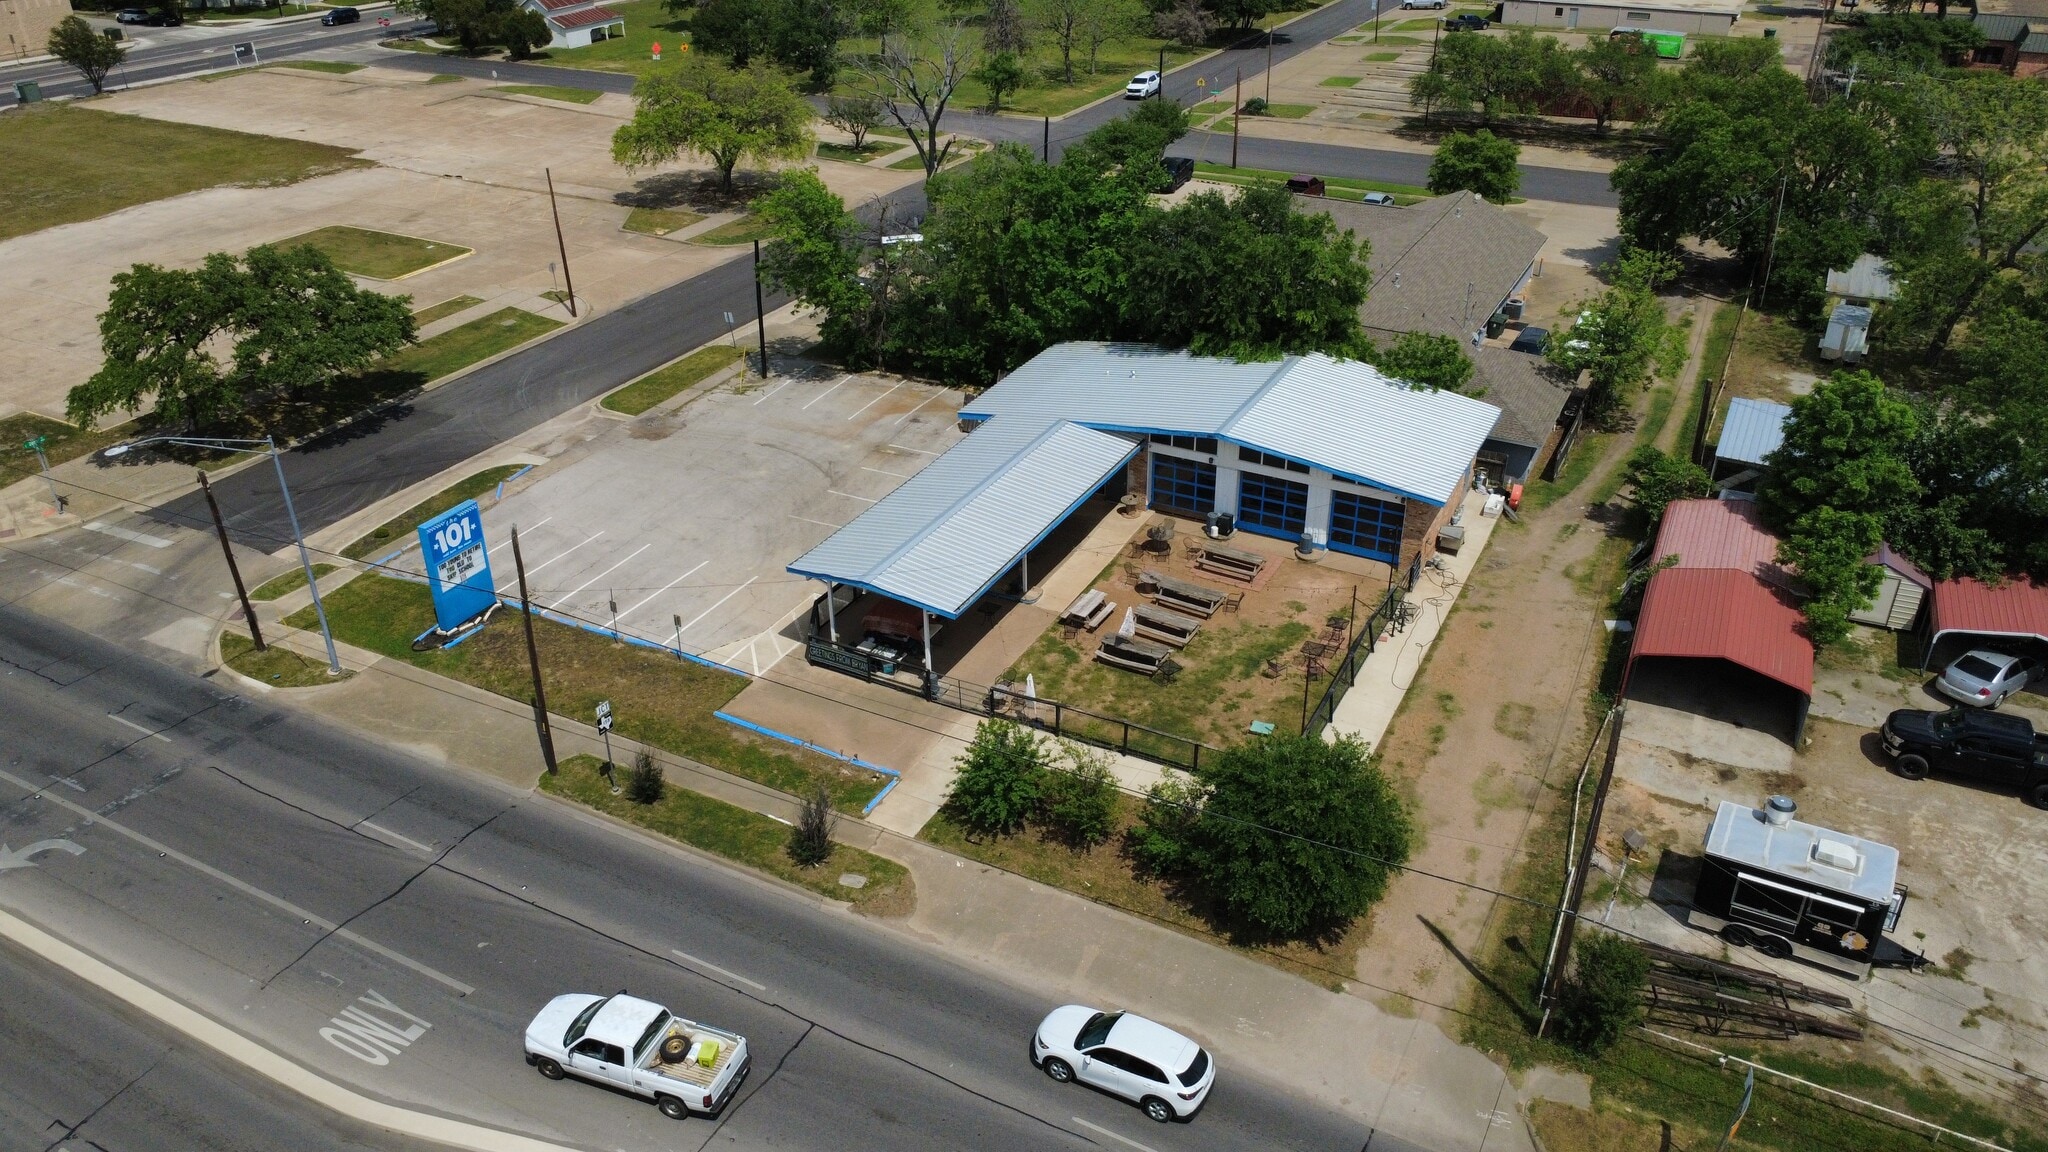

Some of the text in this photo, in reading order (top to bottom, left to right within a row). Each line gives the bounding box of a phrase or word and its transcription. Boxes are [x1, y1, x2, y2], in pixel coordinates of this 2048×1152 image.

[435, 516, 472, 554] 101
[438, 562, 447, 571] TOO
[447, 555, 461, 567] YOUNG
[461, 550, 468, 559] TO
[467, 543, 481, 556] RETIRE
[446, 555, 473, 574] TOO OLD TO
[447, 571, 457, 581] SKIP
[458, 562, 474, 574] SCHOOL
[810, 646, 869, 672] GREETINGS FROM BRYAN
[598, 702, 609, 715] JCT
[319, 988, 433, 1066] ONLY
